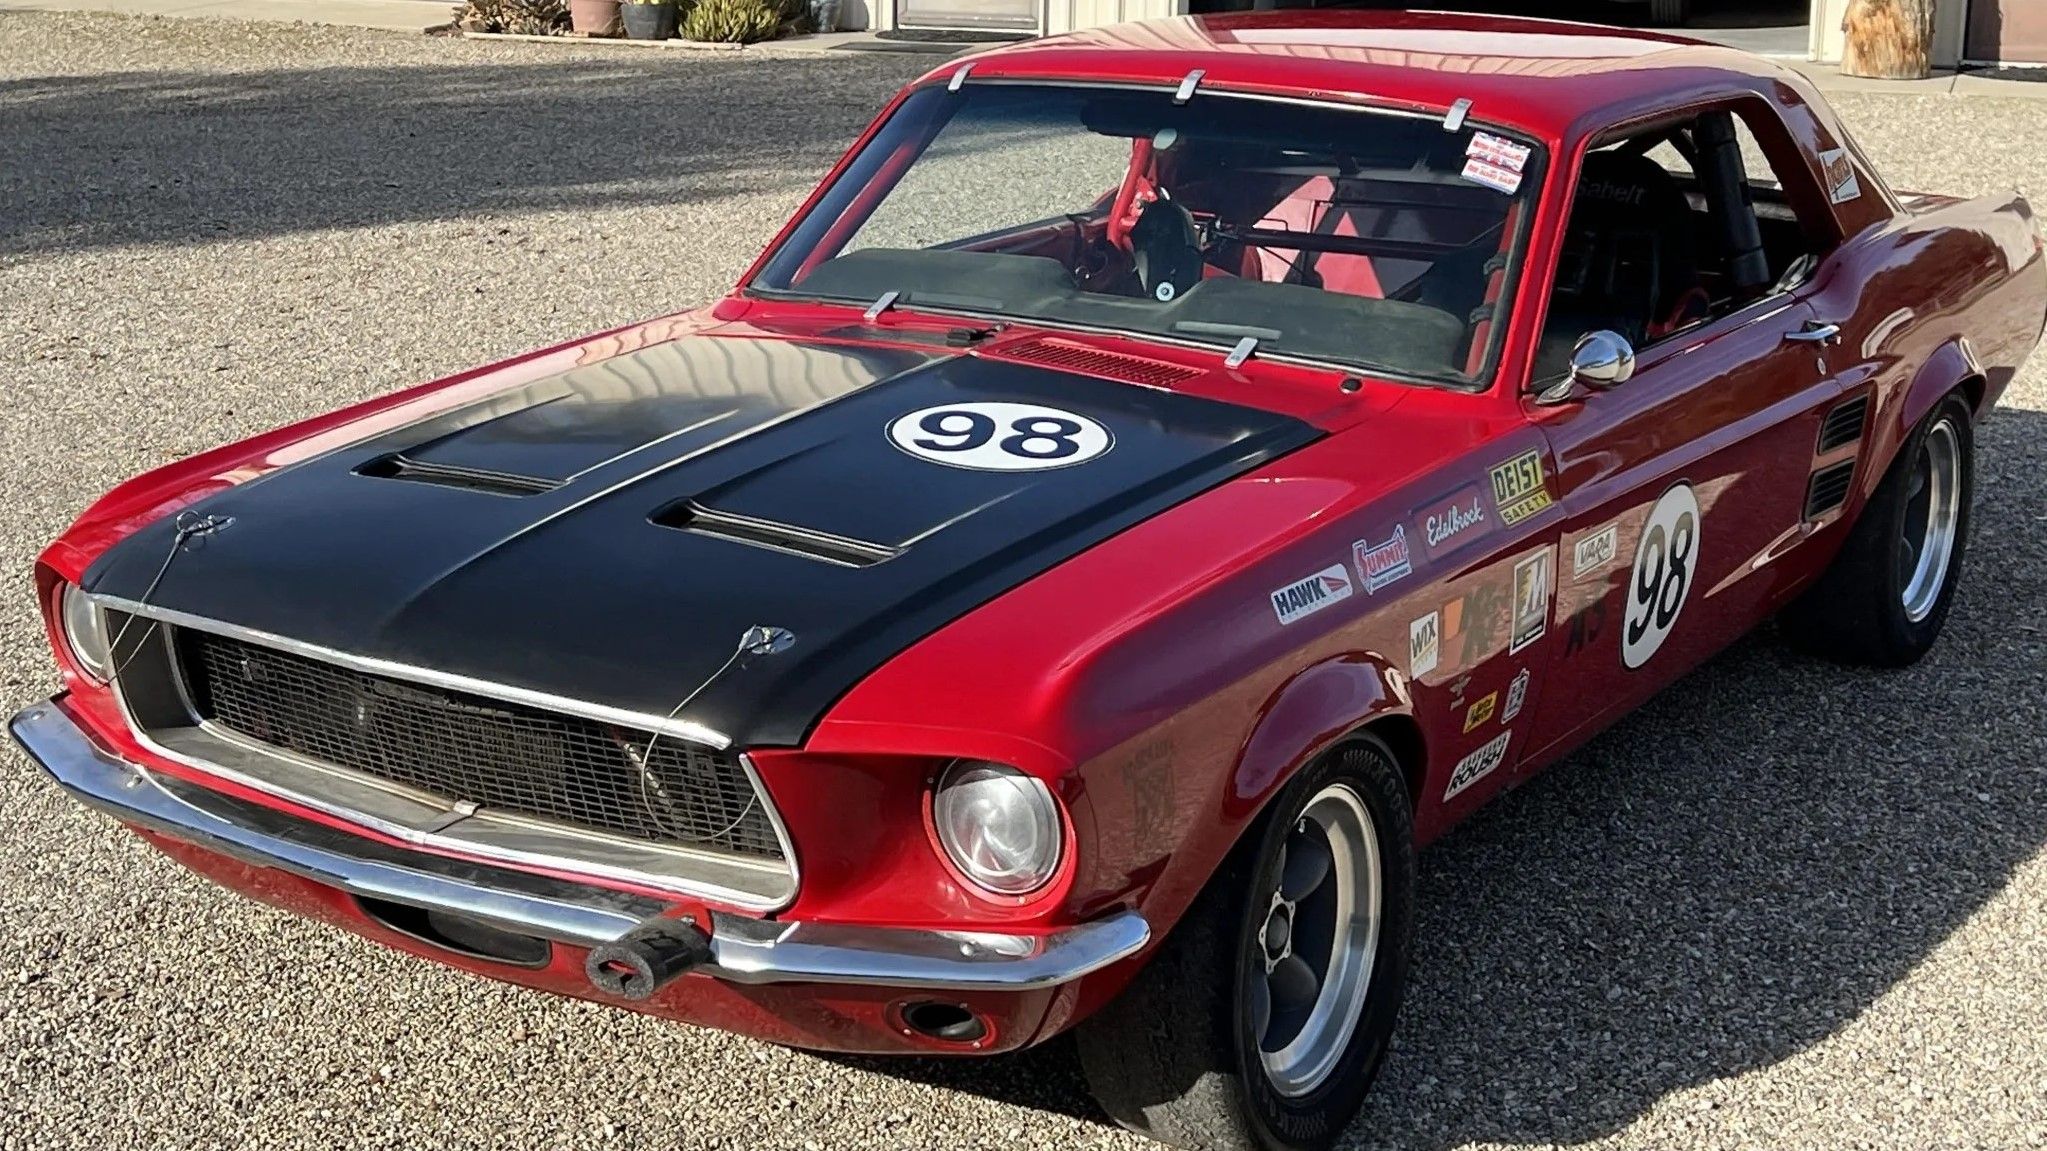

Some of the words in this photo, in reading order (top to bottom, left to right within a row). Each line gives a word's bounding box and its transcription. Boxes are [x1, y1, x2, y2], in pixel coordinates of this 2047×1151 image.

[913, 410, 1082, 459] 98
[1493, 452, 1541, 501] DEIST
[1426, 497, 1484, 547] Edelbrock
[1502, 492, 1550, 522] SAFETY
[1357, 536, 1407, 580] SUMMIT
[1580, 533, 1611, 565] VARA
[1274, 577, 1326, 616] HAWK
[1628, 511, 1694, 646] 98
[1411, 616, 1436, 659] WIX
[1451, 750, 1501, 789] ROUSH
